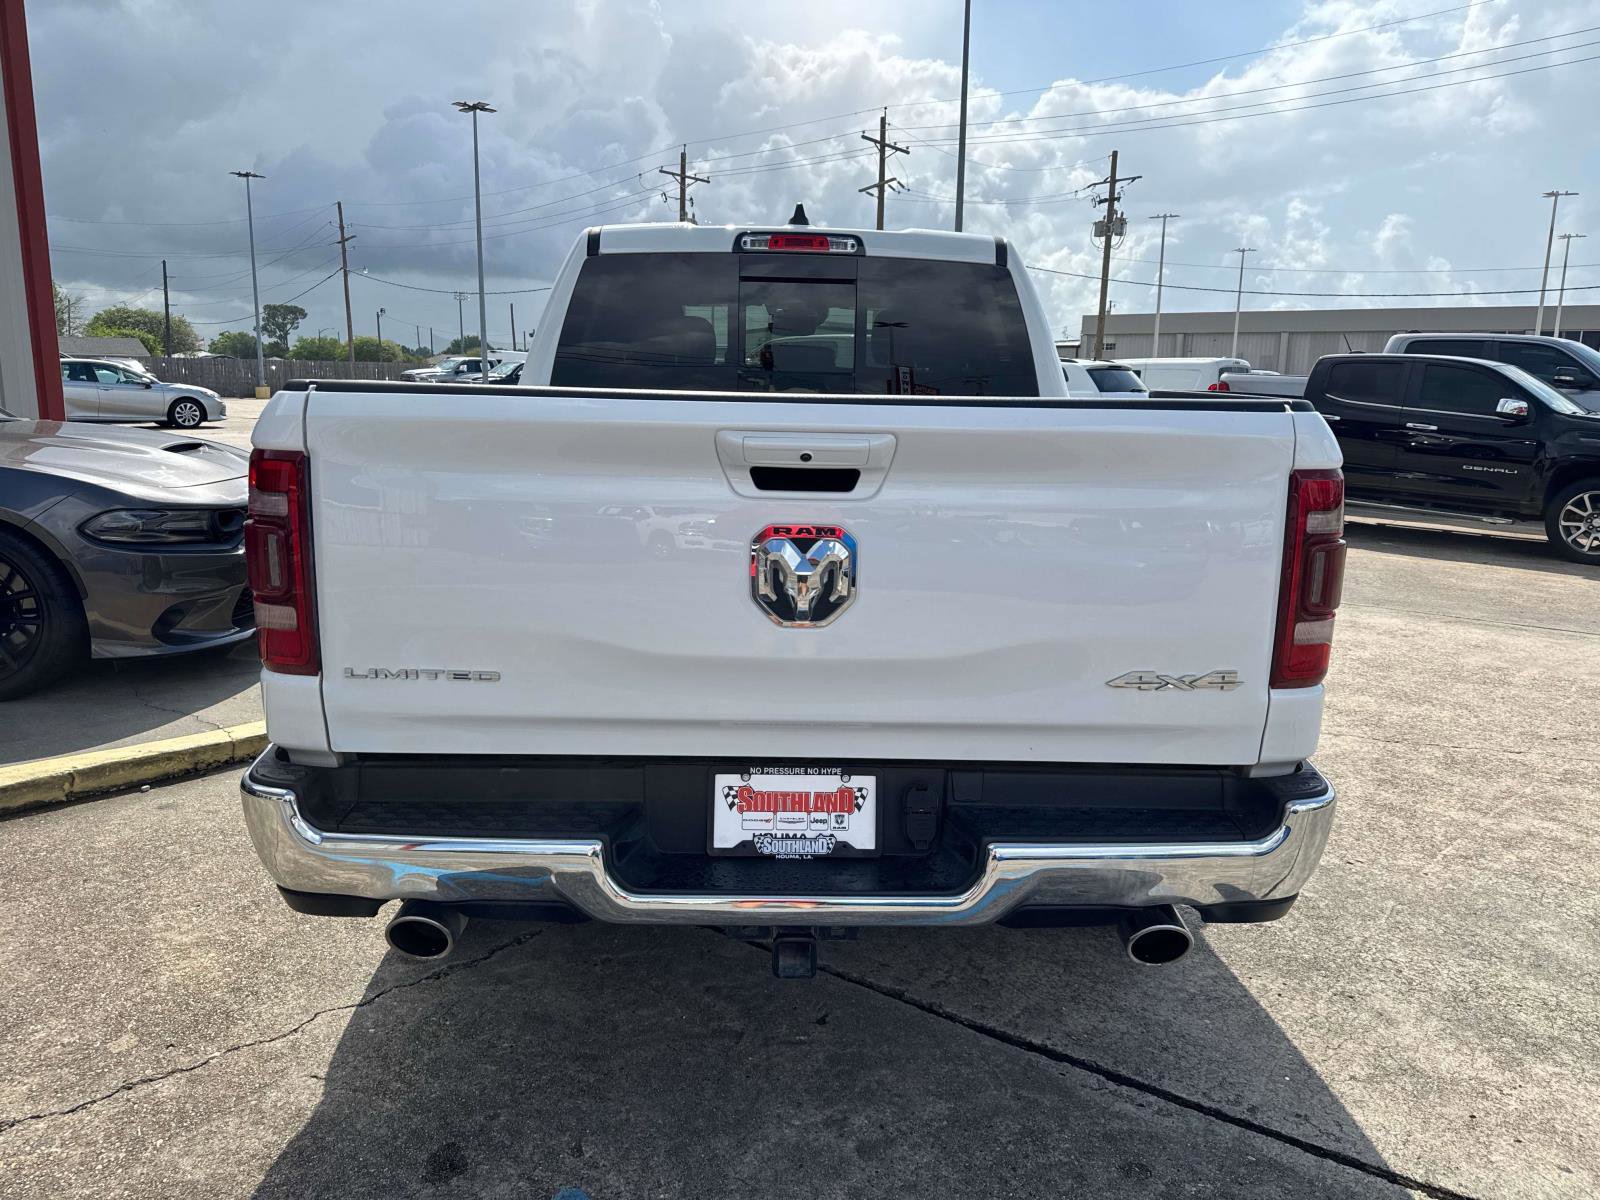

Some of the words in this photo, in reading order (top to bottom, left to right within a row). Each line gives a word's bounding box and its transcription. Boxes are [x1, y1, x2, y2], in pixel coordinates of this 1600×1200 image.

[1463, 465, 1518, 474] DENALI
[773, 527, 836, 536] RAM
[344, 667, 501, 682] LIMITED
[750, 767, 762, 775] NO
[764, 767, 805, 775] PRESSURE
[737, 785, 855, 814] SOUTHLAND
[811, 816, 828, 824] Jeep
[762, 836, 828, 854] SOUTHLAND
